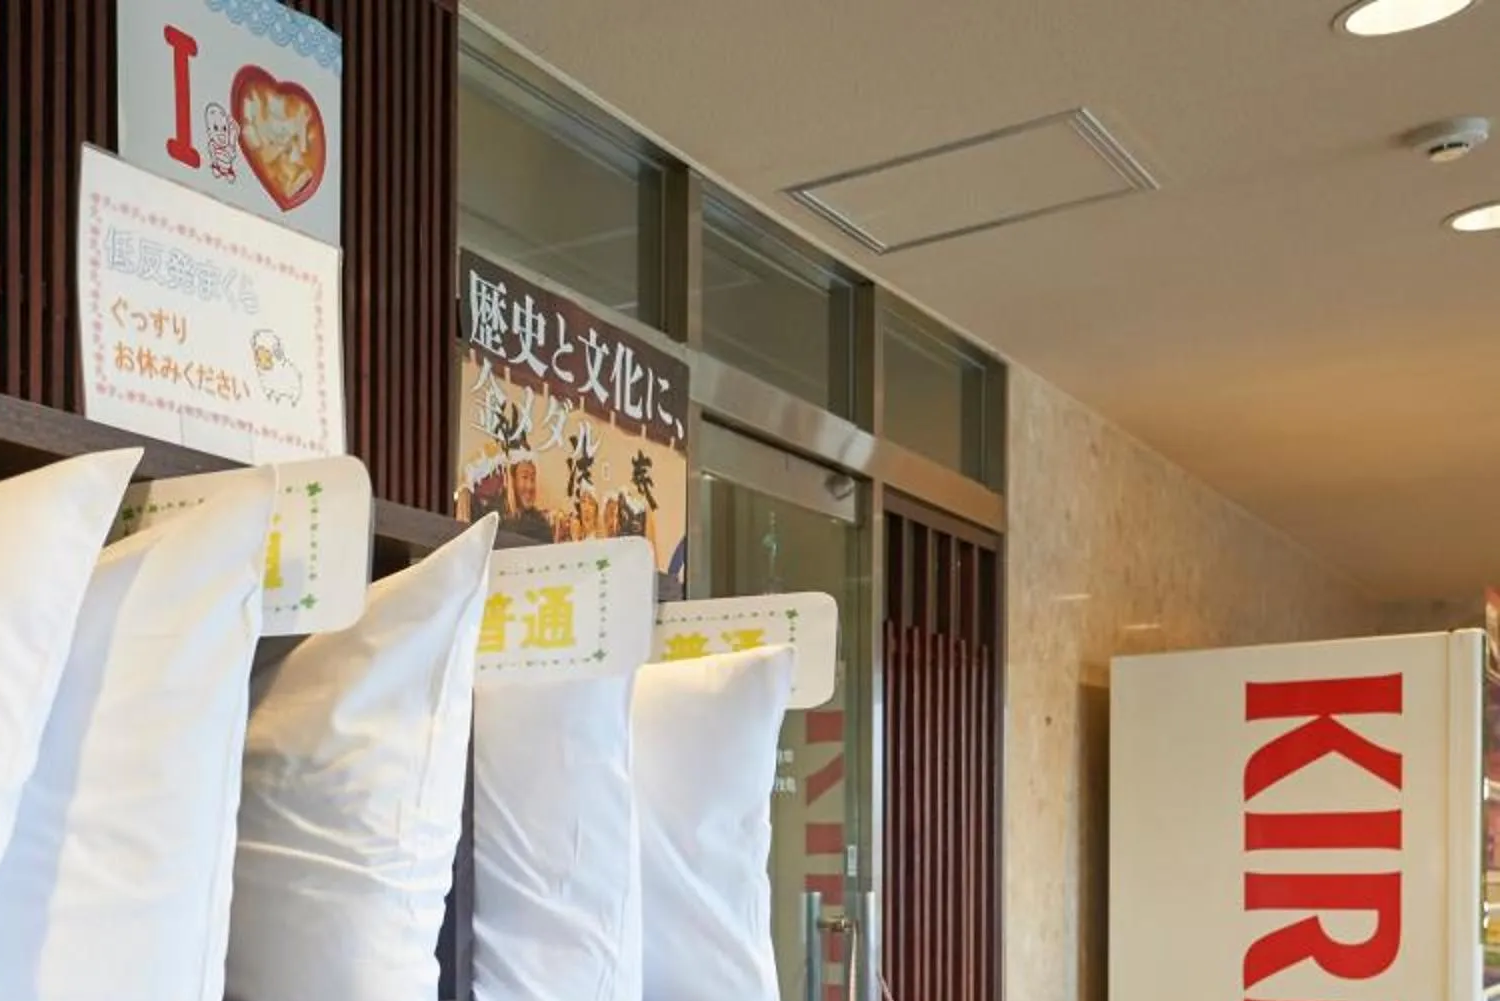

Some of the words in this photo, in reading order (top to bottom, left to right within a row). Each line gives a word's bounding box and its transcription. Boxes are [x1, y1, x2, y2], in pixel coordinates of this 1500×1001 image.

[111, 297, 187, 345] ぐっすり
[113, 341, 251, 401] お休みください
[469, 270, 684, 441] 歴史と文化に、
